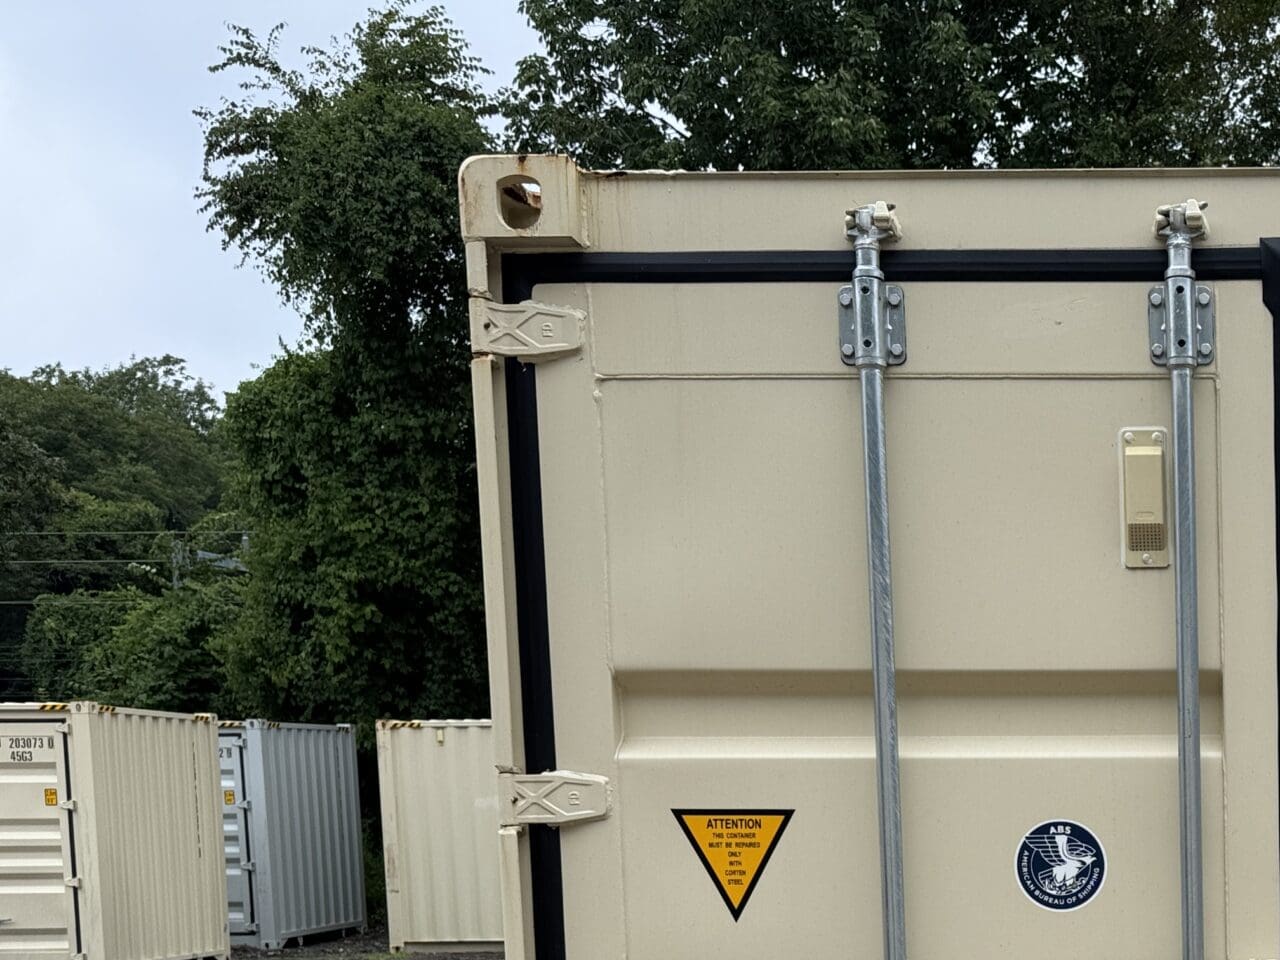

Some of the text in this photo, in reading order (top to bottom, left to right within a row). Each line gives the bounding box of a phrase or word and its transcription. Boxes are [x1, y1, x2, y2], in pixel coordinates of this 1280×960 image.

[706, 818, 763, 830] ATTENTION
[1049, 825, 1071, 834] ABS
[727, 878, 744, 886] STEEL
[1021, 850, 1100, 905] AMERICAN BUREAU OF SHIPPING
